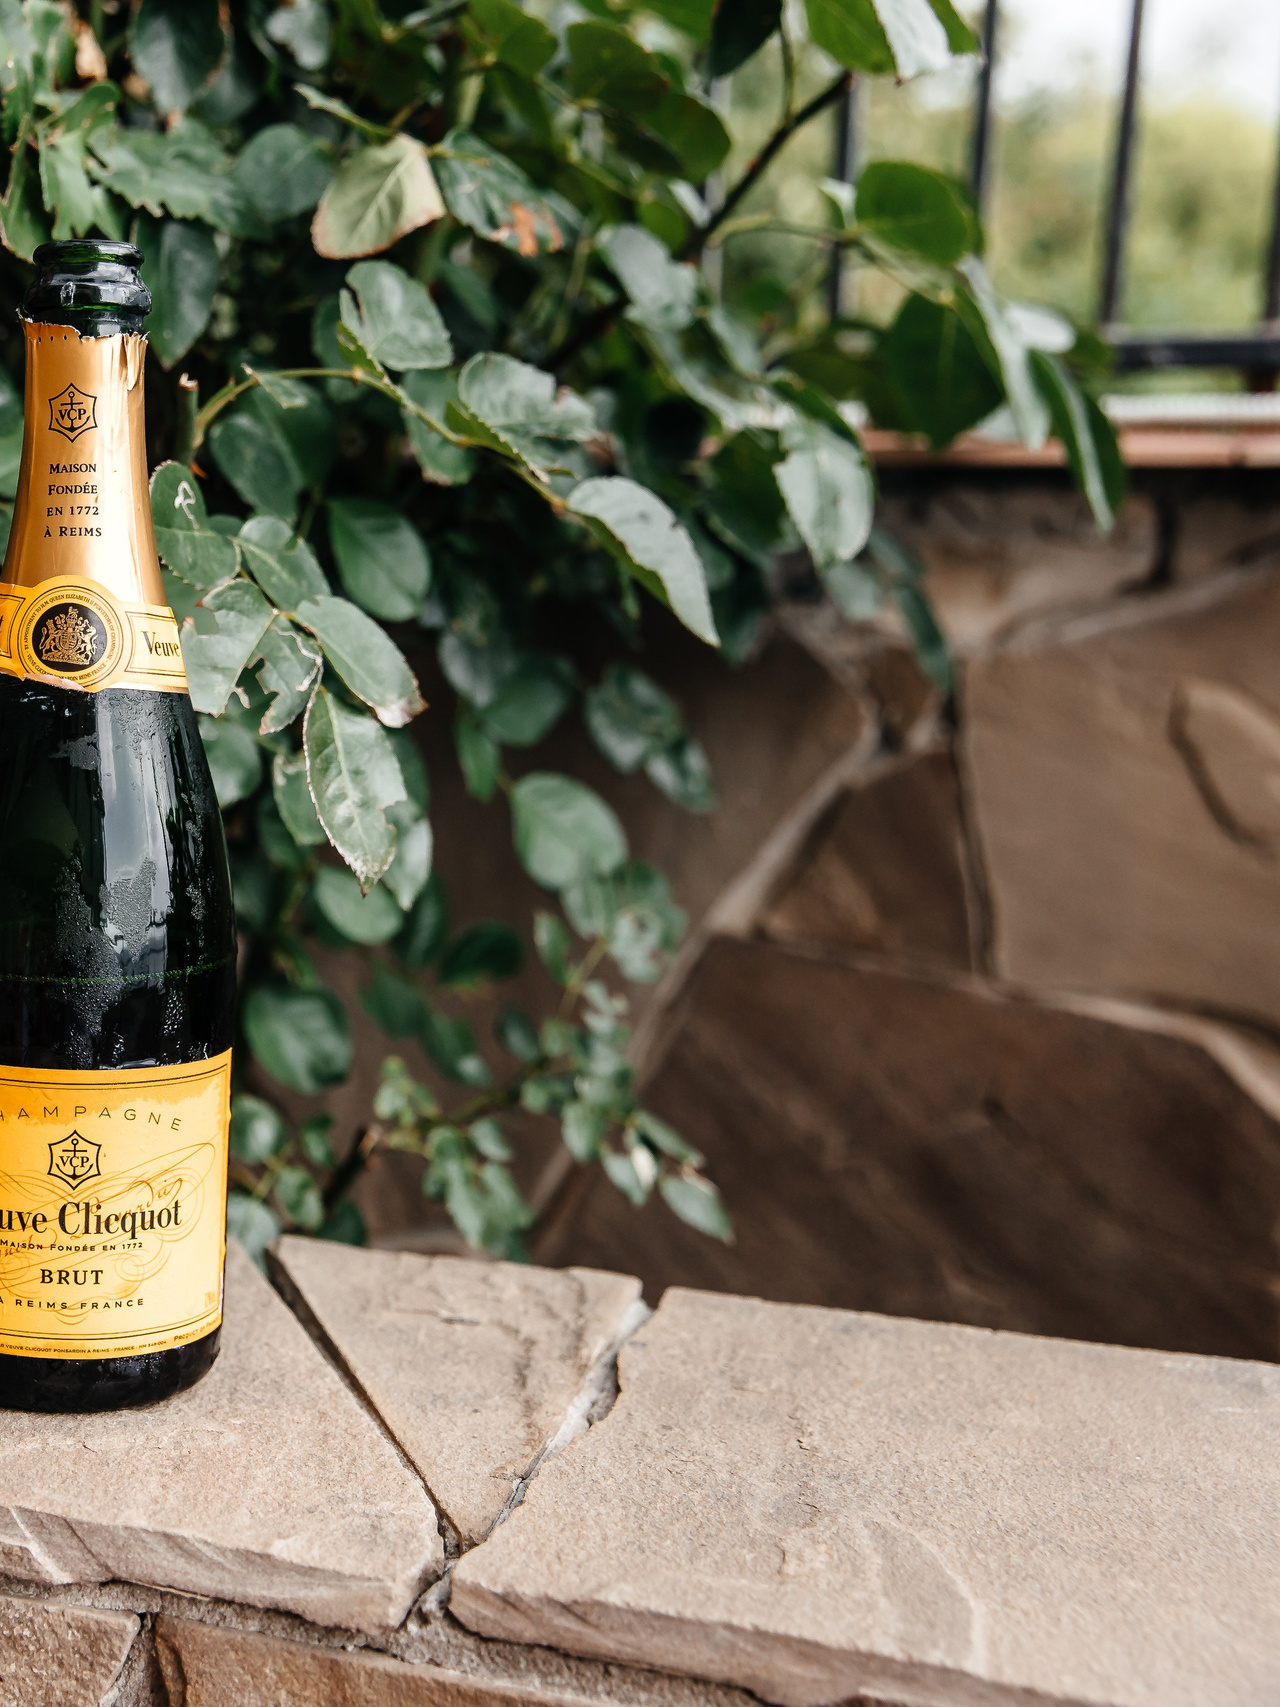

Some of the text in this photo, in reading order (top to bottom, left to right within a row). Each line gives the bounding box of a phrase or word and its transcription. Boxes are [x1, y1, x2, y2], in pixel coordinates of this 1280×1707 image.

[58, 408, 87, 421] VCP
[49, 463, 97, 474] MAISON
[48, 482, 98, 496] FONDÉE
[47, 506, 99, 517] EN 1772
[43, 526, 102, 538] À REIMS
[141, 631, 180, 657] Veuve
[58, 1155, 90, 1168] VCP
[58, 1199, 182, 1240] Clicquot
[0, 1239, 43, 1250] MAISON
[50, 1243, 96, 1252] FONDÉE
[122, 1242, 143, 1250] 1772
[40, 1269, 103, 1285] BRUT
[16, 1299, 68, 1310] REIMS
[80, 1298, 144, 1310] FRANCE
